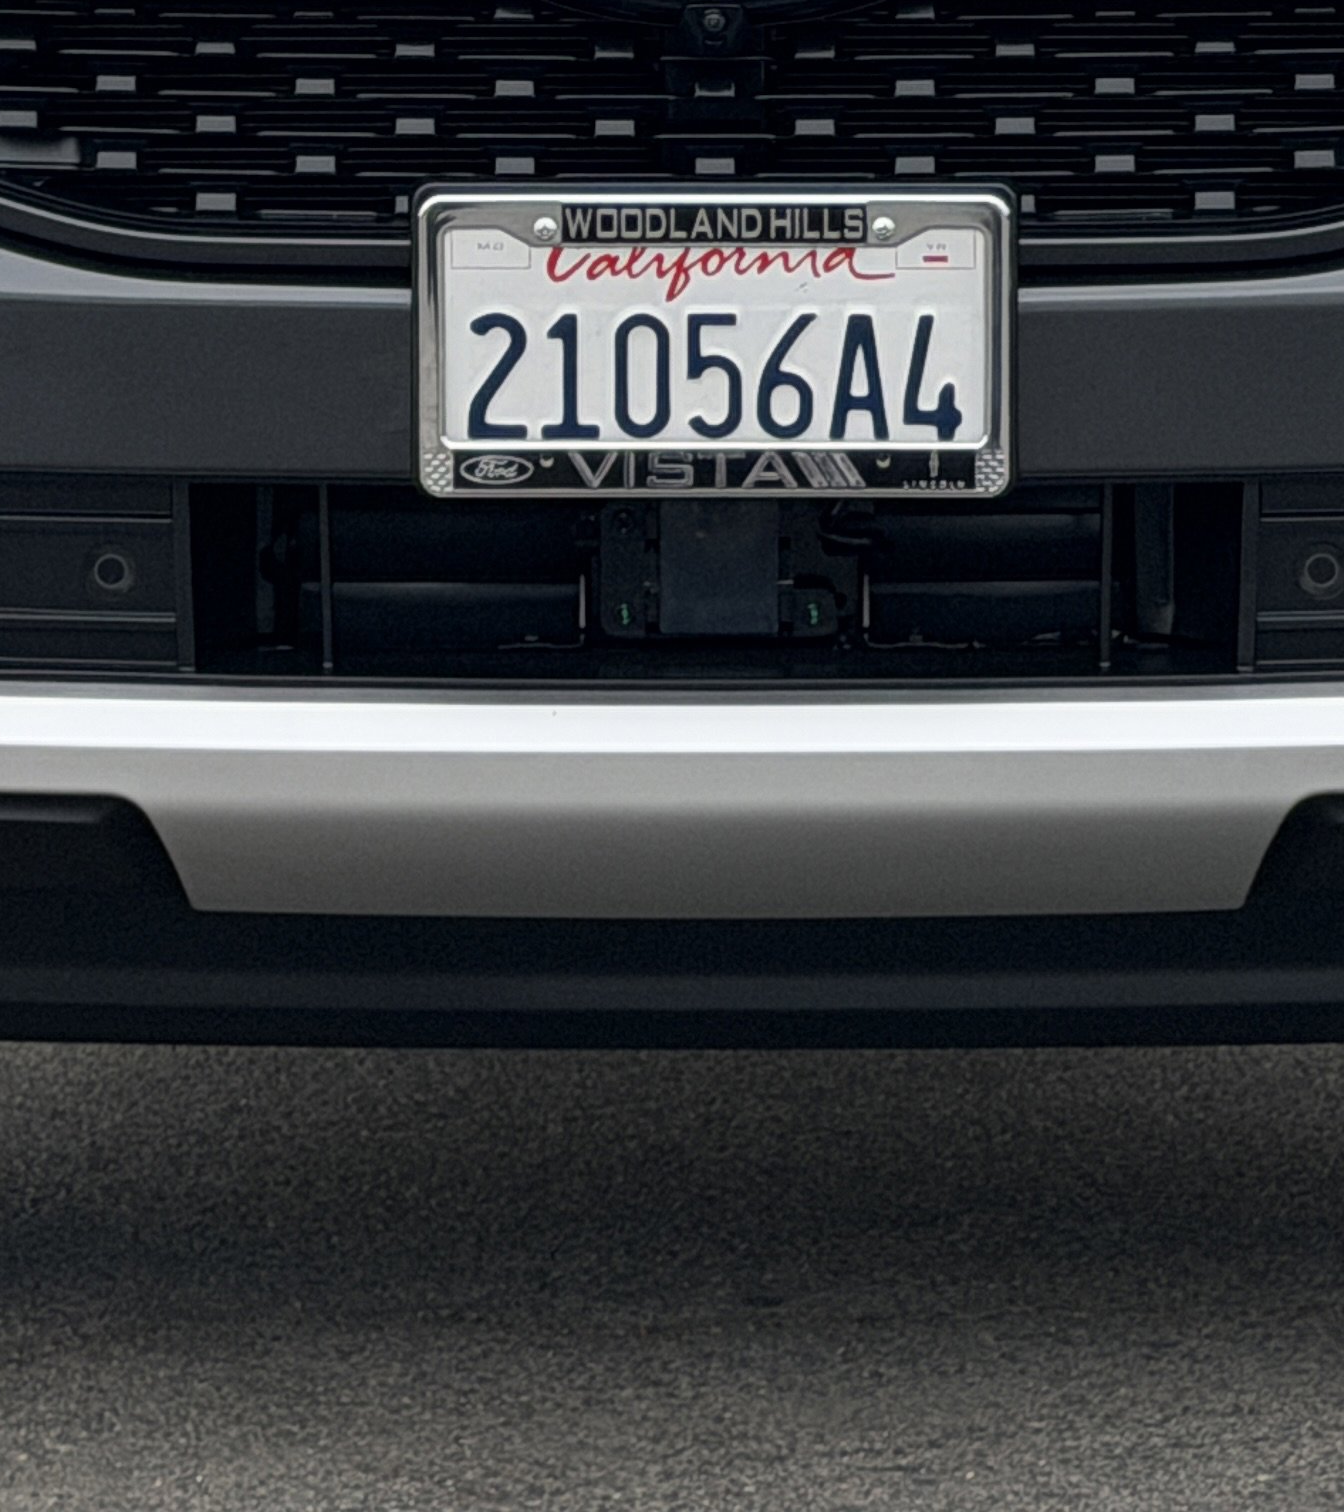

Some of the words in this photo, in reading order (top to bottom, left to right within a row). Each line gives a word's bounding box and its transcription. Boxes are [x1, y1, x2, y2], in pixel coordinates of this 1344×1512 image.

[564, 208, 763, 240] WOODLAND
[769, 208, 865, 240] HILLS
[545, 246, 896, 302] California
[466, 312, 963, 441] 21056A4
[473, 458, 519, 479] Ford
[567, 451, 799, 488] VISTA
